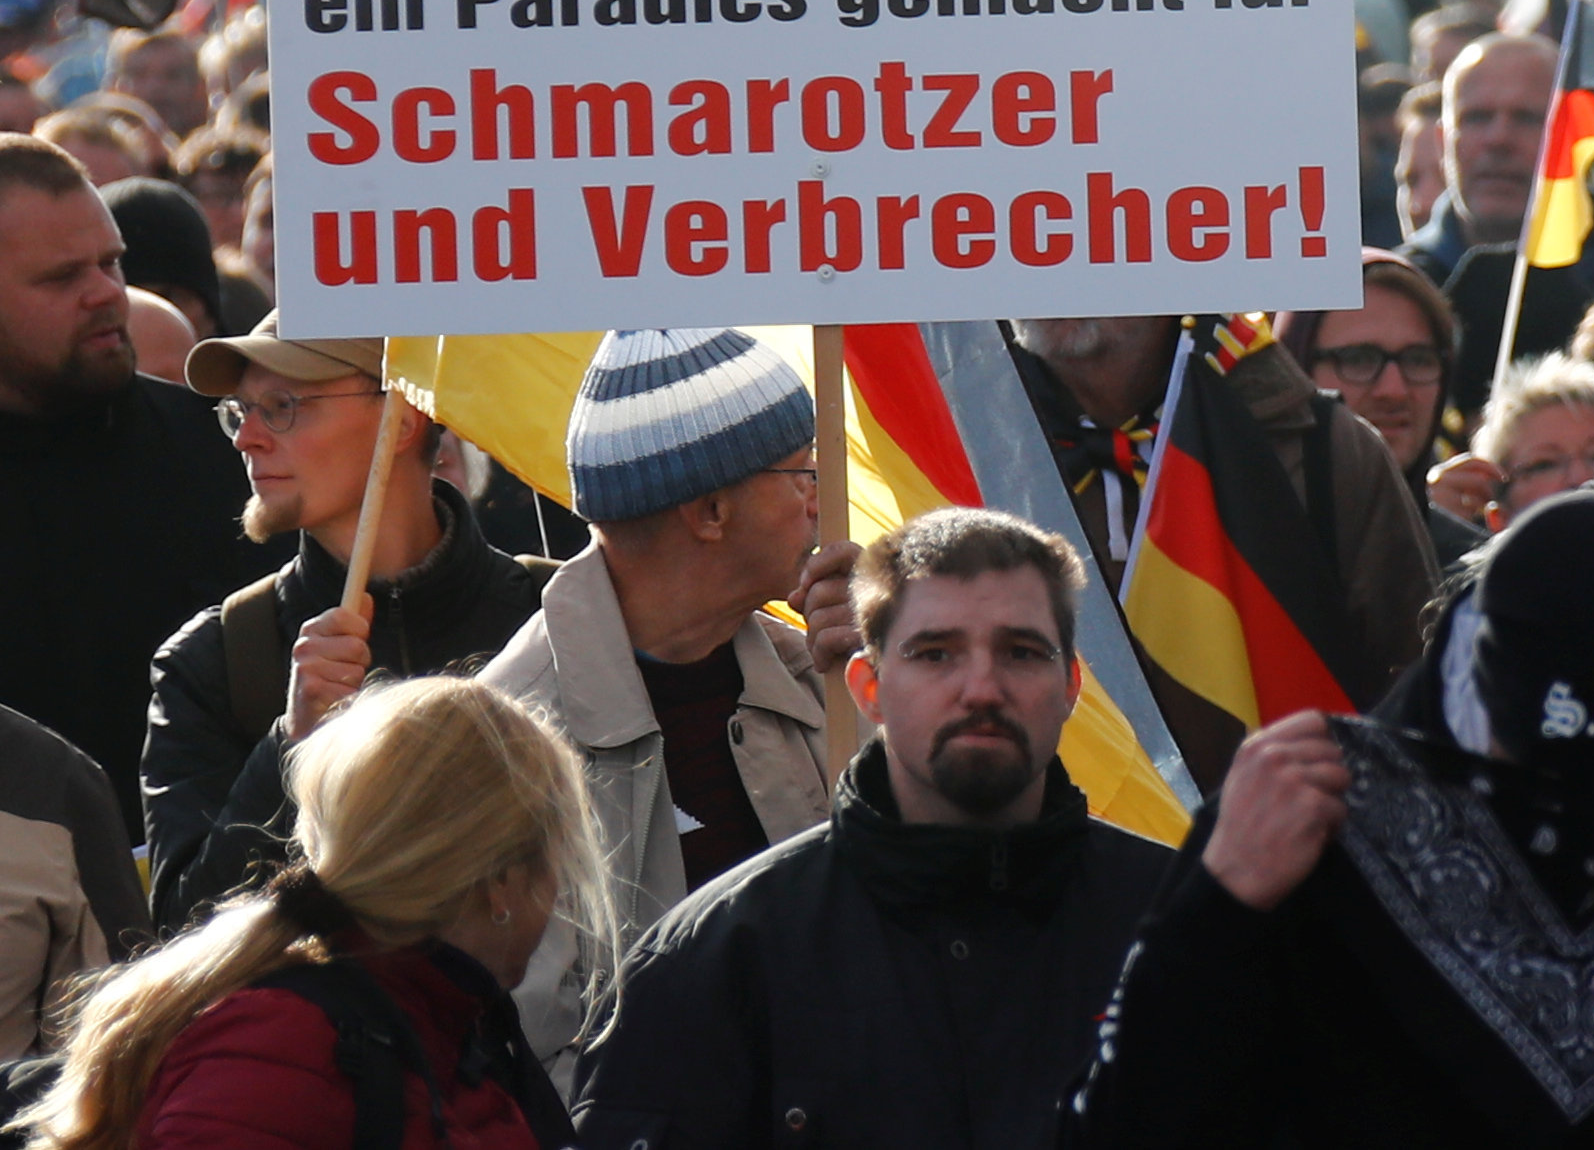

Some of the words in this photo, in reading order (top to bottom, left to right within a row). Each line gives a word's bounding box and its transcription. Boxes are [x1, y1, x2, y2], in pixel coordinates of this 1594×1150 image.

[308, 62, 1113, 165] Schmarotzer
[313, 188, 537, 286] und
[582, 167, 1326, 278] Verbrecher!
